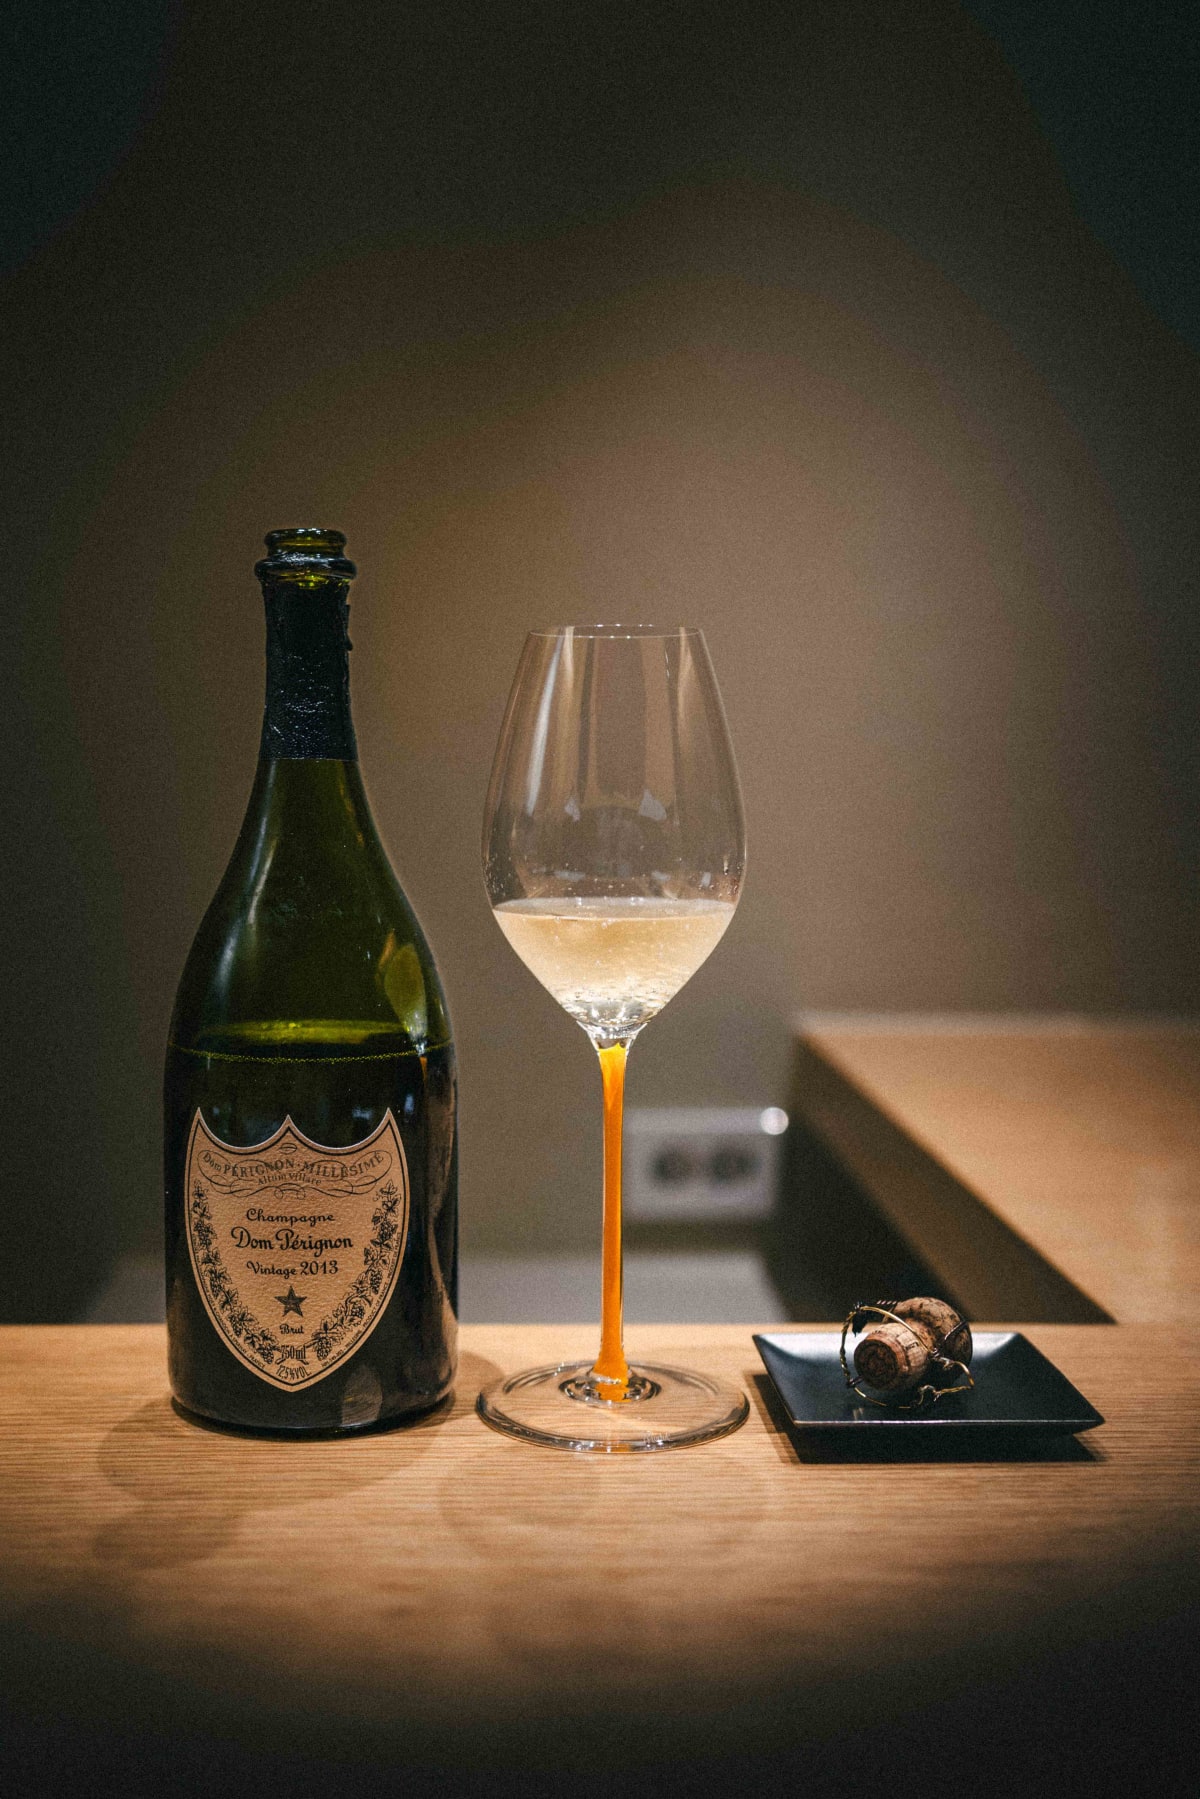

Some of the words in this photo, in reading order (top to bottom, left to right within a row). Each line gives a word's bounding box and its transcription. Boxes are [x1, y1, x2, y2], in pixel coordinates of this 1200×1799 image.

[246, 1208, 336, 1227] Champagne
[230, 1226, 274, 1250] Dom
[275, 1228, 354, 1258] Pérignon
[246, 1260, 298, 1280] Vintage
[300, 1260, 339, 1276] 2013
[279, 1323, 304, 1335] Brut
